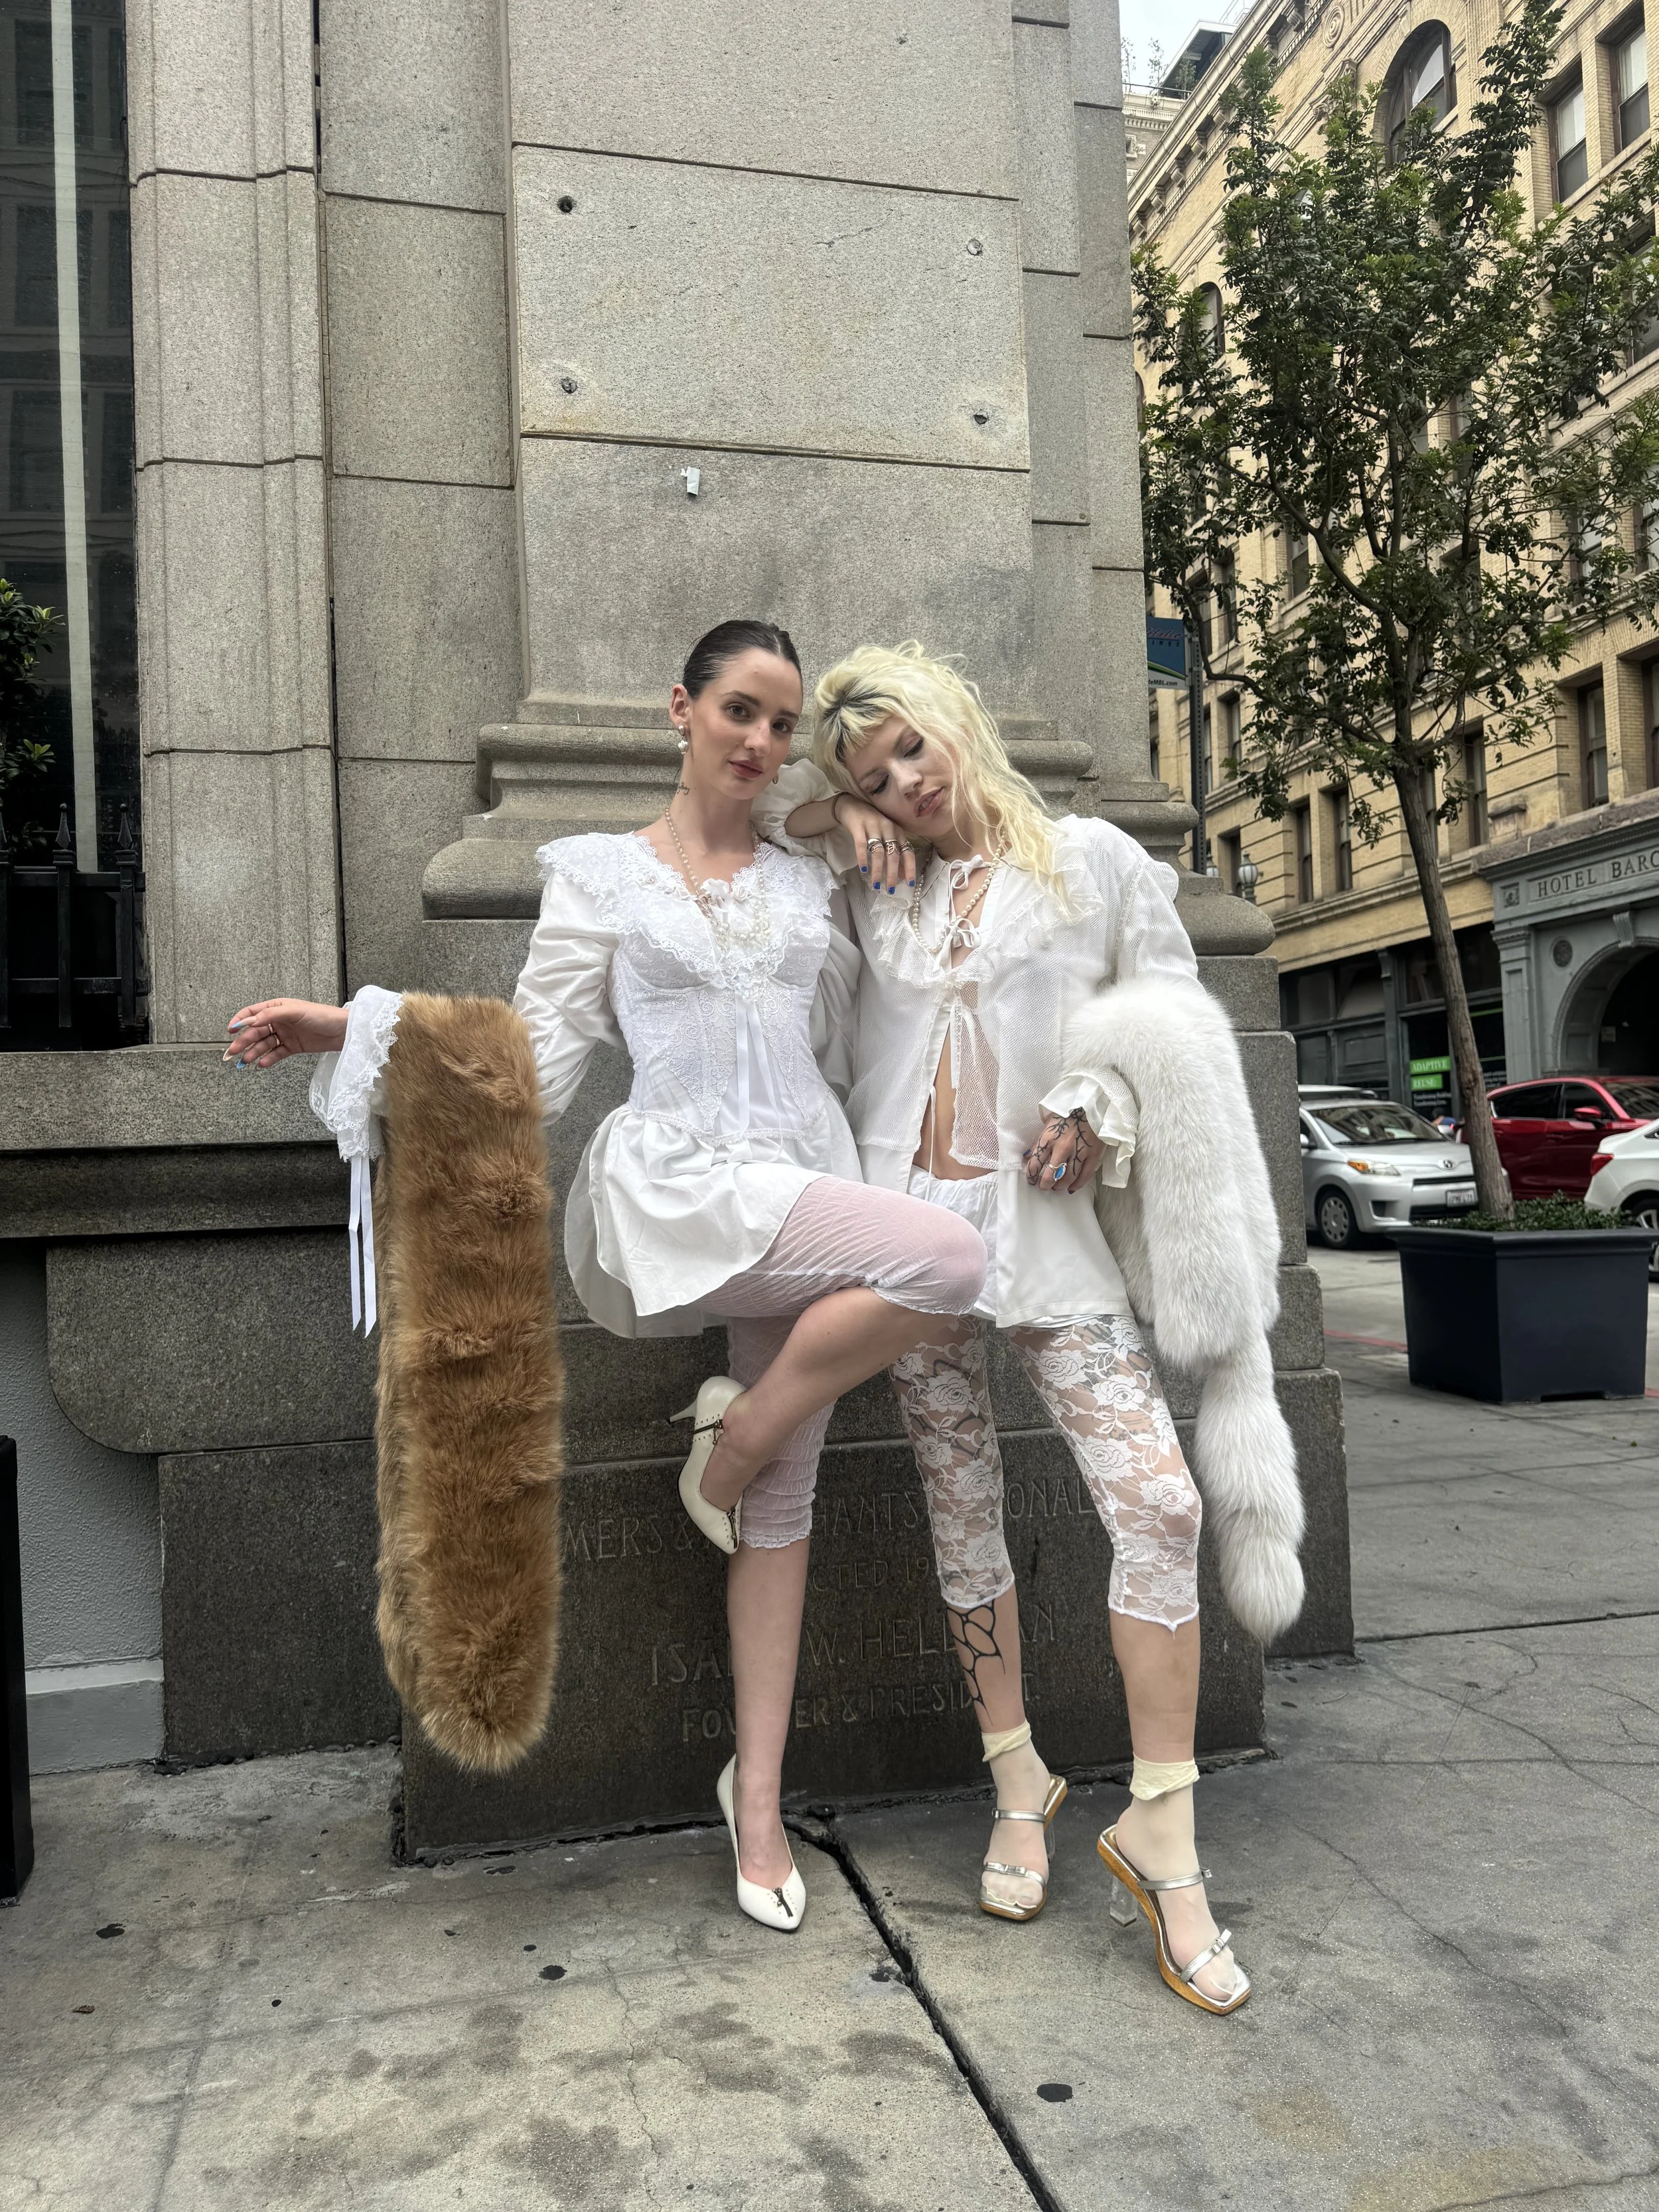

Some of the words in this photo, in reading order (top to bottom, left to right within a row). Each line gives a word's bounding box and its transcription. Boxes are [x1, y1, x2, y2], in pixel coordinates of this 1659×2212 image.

[1538, 868, 1597, 897] HOTEL
[1412, 1059, 1447, 1071] ADAPTIVE
[563, 1513, 662, 1561] MERS
[673, 1512, 692, 1550] &
[1007, 1478, 1096, 1518] ONAL
[813, 1560, 889, 1591] CTED
[906, 1556, 929, 1584] 19
[805, 1624, 845, 1666] W.
[860, 1601, 1056, 1659] HELLN
[841, 1694, 858, 1723] &
[870, 1672, 1040, 1720] PRESIDT.
